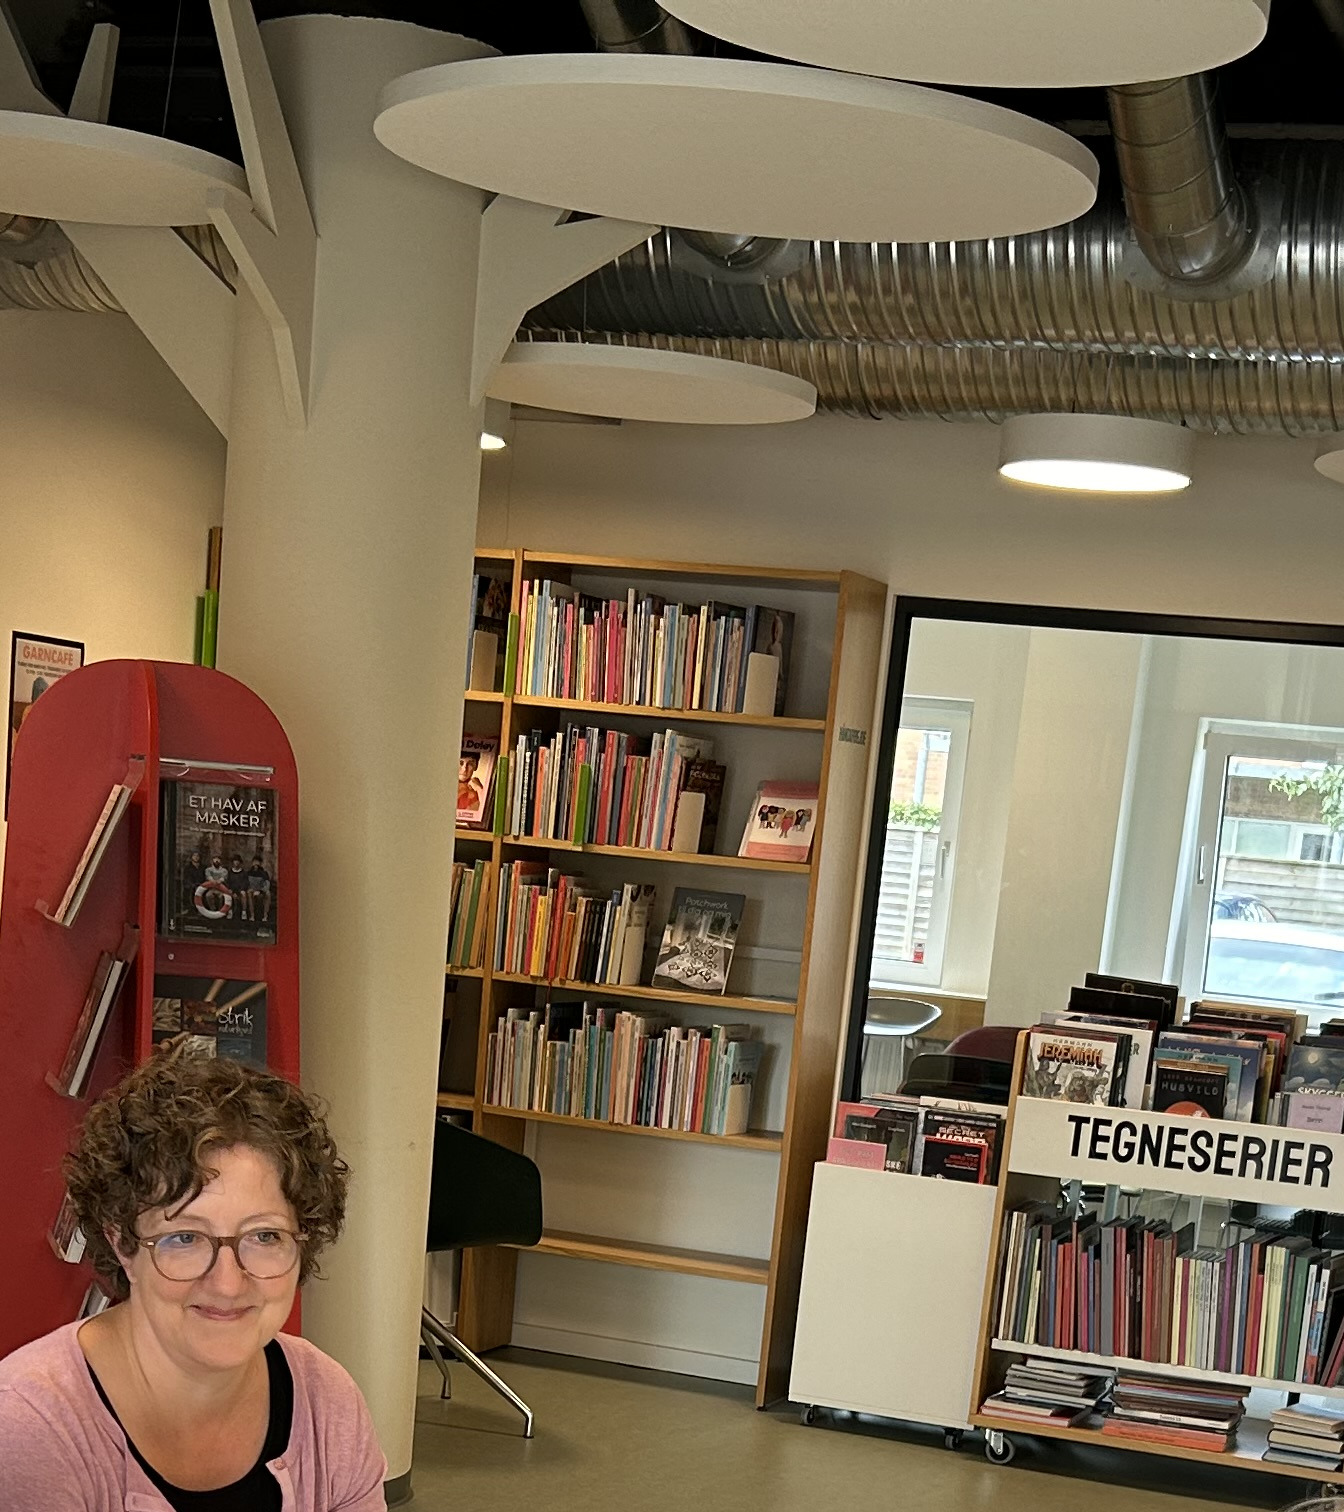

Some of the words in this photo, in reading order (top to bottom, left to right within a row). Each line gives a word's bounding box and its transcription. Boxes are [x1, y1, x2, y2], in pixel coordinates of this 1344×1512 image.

[189, 795, 208, 809] ET
[211, 797, 244, 812] HAV
[246, 801, 268, 814] AF
[195, 810, 260, 828] MASKER
[686, 896, 729, 910] Patchwork
[1161, 1081, 1220, 1096] HUSVILD
[938, 1125, 986, 1139] SECRET
[1067, 1114, 1334, 1188] TEGNESERIER
